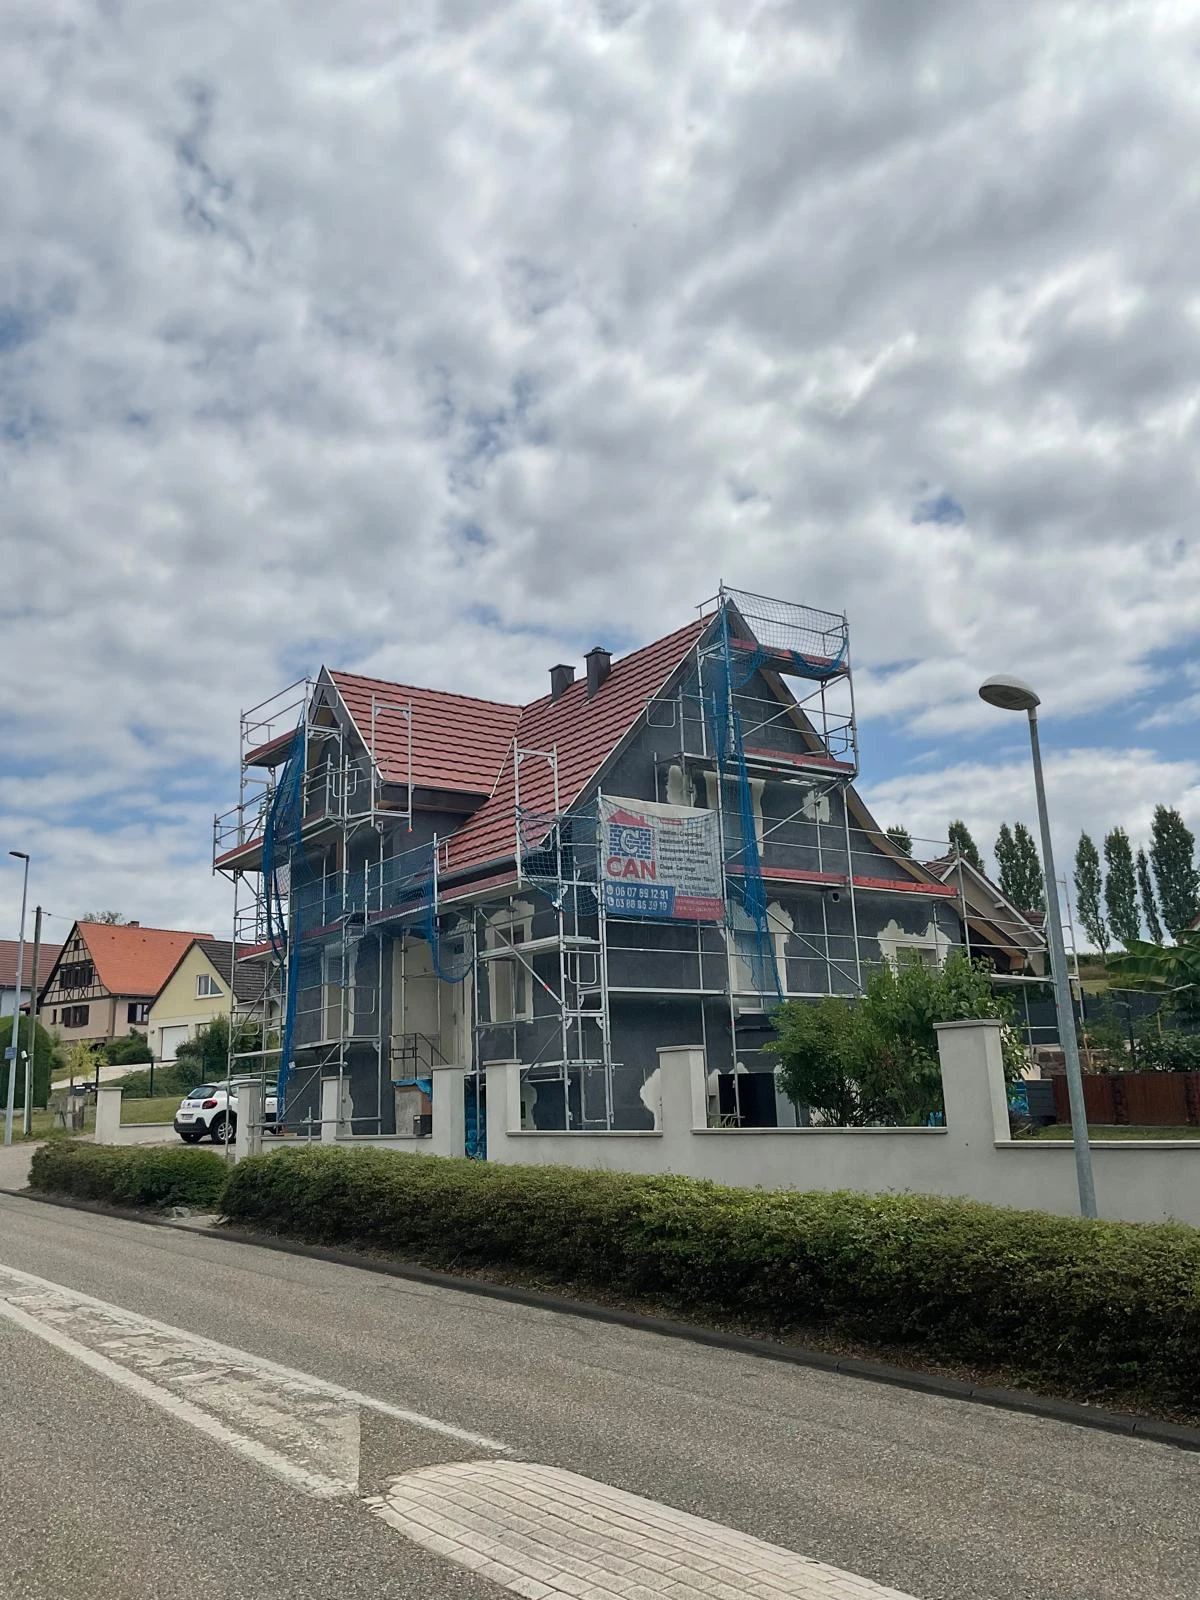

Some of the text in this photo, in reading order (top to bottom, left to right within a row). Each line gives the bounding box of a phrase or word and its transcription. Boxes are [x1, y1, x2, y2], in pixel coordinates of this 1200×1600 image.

[607, 857, 656, 881] CAN
[615, 886, 626, 897] 06
[627, 887, 637, 898] 07
[650, 889, 659, 899] 12
[660, 889, 669, 900] 91
[615, 898, 625, 908] 03
